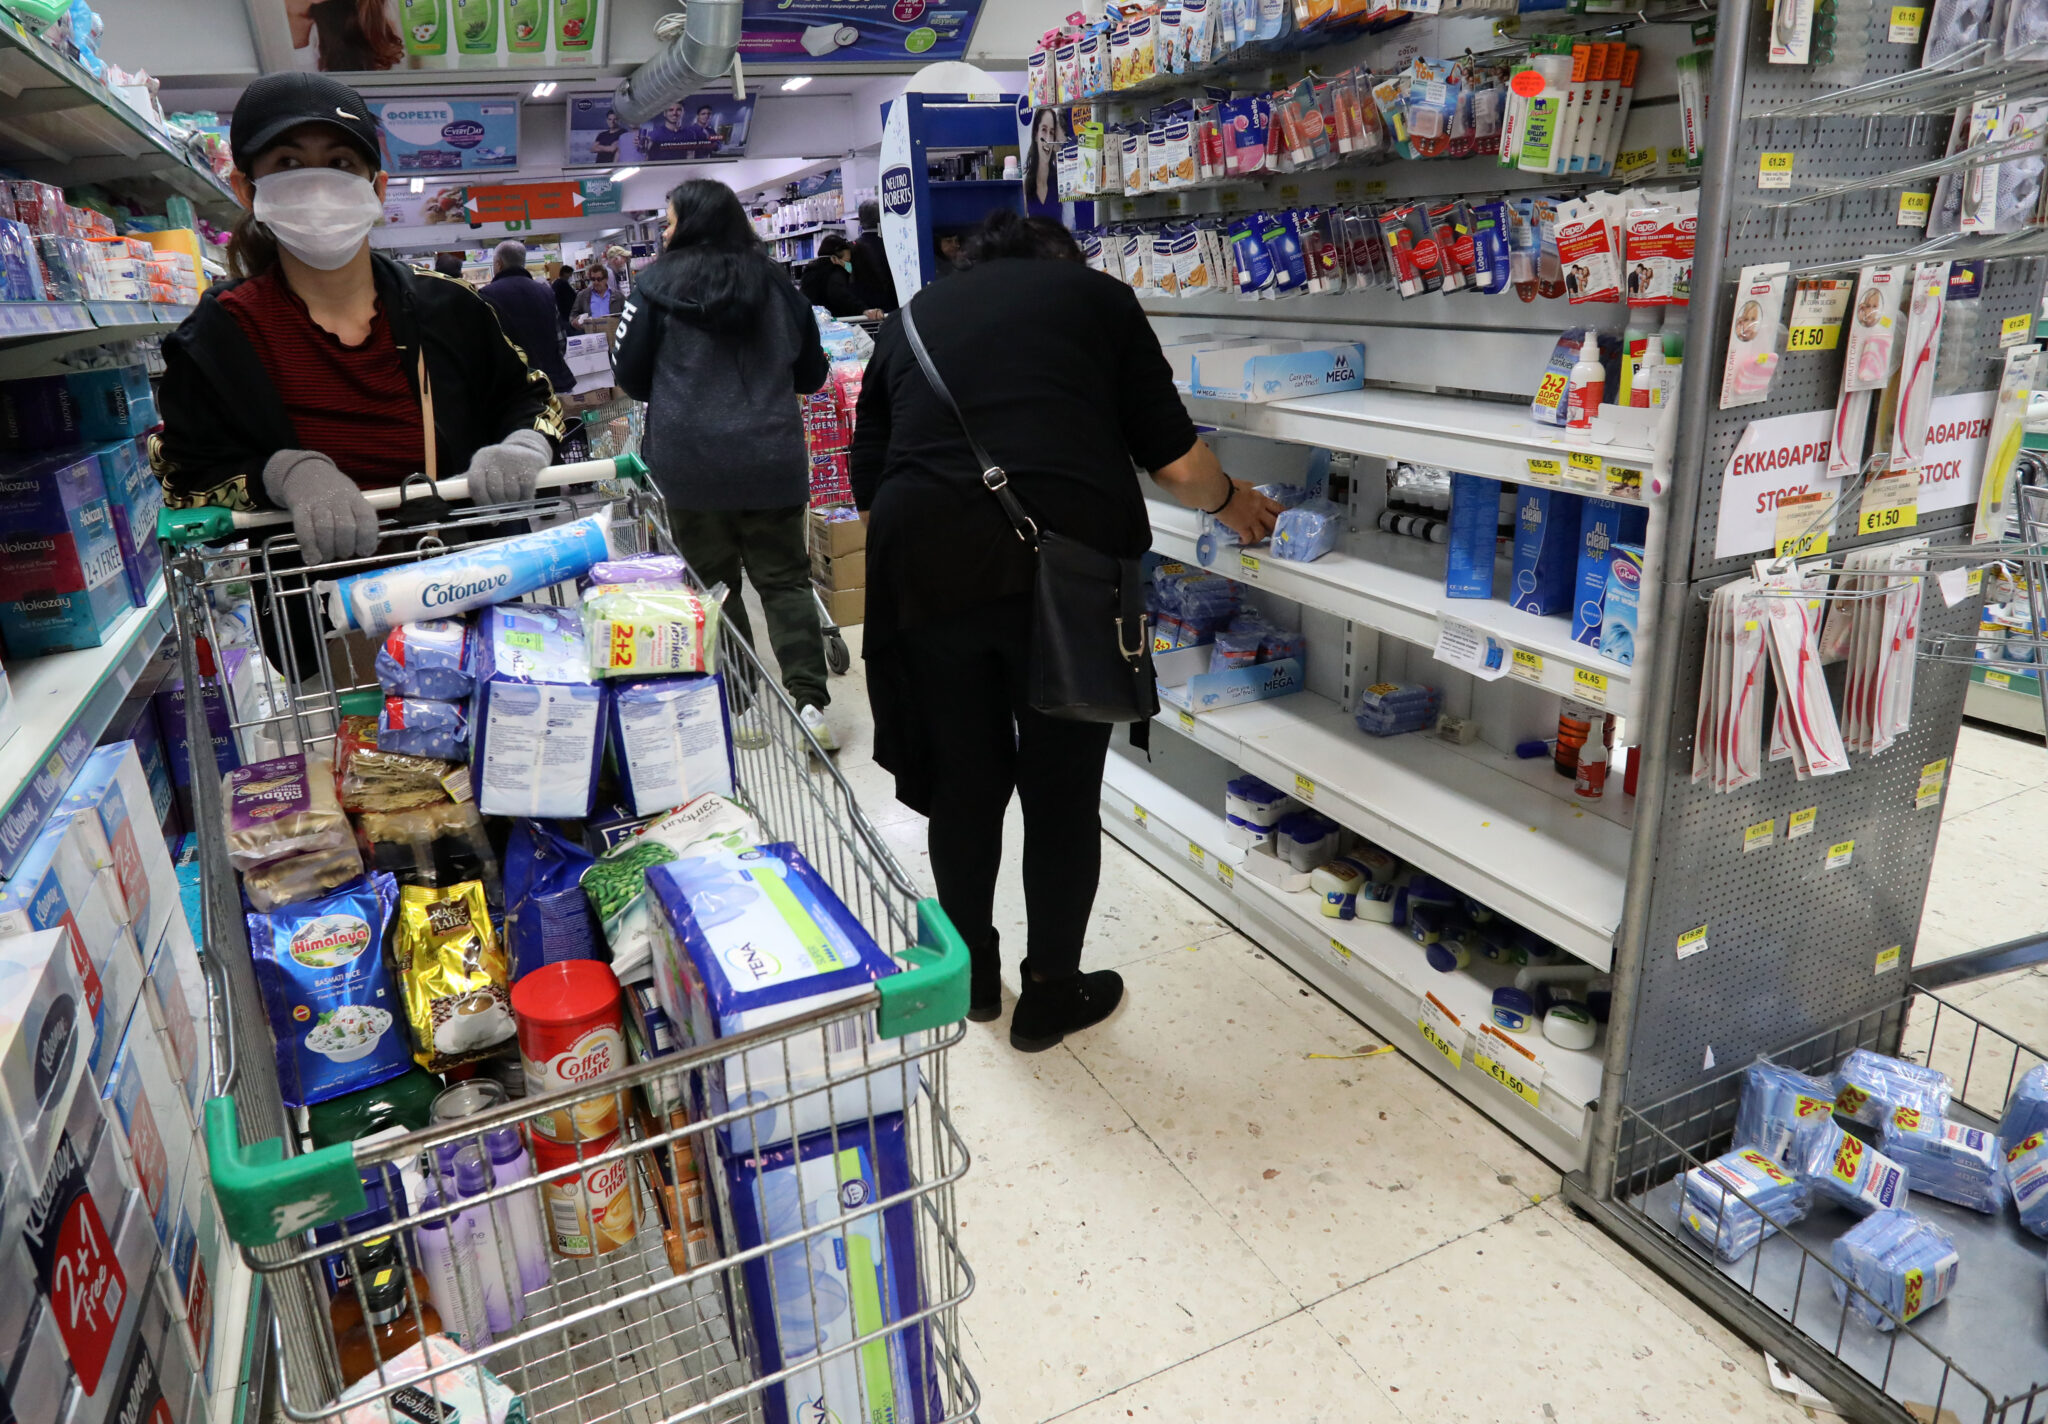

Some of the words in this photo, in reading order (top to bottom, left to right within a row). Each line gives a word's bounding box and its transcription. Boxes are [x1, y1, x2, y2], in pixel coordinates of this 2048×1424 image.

[1899, 12, 1916, 22] €1.15
[387, 110, 447, 120] ΦΟΡΕΣΤΕ
[1503, 135, 1512, 158] After
[1688, 130, 1697, 154] After
[1768, 157, 1787, 168] €1.25
[885, 173, 907, 190] NEUTRO
[884, 187, 912, 207] ROBERTS
[1908, 197, 1924, 206] €1.00
[1476, 240, 1485, 271] Labello
[1792, 328, 1824, 346] €1.50
[1551, 356, 1574, 369] hankies
[1289, 373, 1301, 382] Care
[1302, 374, 1313, 383] you
[1326, 369, 1356, 383] MEGA
[1541, 374, 1566, 393] 2+2
[113, 382, 128, 425] Alokozay
[1538, 390, 1560, 400] ΔΩΡΟ
[1925, 417, 1992, 446] ΑΘΑΡΙΣΗ
[1572, 454, 1594, 465] €1.95
[0, 477, 40, 492] kozay
[1529, 496, 1540, 508] ALL
[1588, 497, 1616, 509] AVIZOR
[80, 505, 104, 526] Alokozay
[1522, 507, 1542, 524] clean
[1867, 510, 1900, 529] €1.50
[1594, 522, 1607, 536] ALL
[1586, 534, 1610, 551] clean
[85, 557, 103, 585] 2+1
[101, 545, 122, 570] FREE
[1586, 548, 1604, 563] Soft
[422, 573, 507, 608] Cotoneve
[12, 596, 72, 613] Alokozay
[616, 625, 634, 666] 2+2
[1264, 677, 1294, 691] MEGA
[1578, 671, 1600, 685] €4.45
[36, 886, 61, 923] Kleenex
[293, 928, 368, 954] Himalaya
[740, 941, 768, 981] TENA
[314, 973, 344, 988] BASMATI
[345, 968, 361, 982] RICE
[40, 1016, 68, 1075] Kleenex
[1423, 1026, 1449, 1055] €1.50
[556, 1046, 609, 1080] Coffee
[574, 1057, 610, 1083] mate
[1491, 1064, 1523, 1094] €1.50
[1896, 1106, 1920, 1128] 2+2
[1745, 1153, 1784, 1181] 2+2
[1838, 1136, 1863, 1178] 2+2
[587, 1159, 626, 1194] Coffe
[604, 1172, 627, 1198] mat
[1881, 1171, 1898, 1203] SEPTONA
[23, 1139, 75, 1248] Kleenex
[1904, 1274, 1923, 1315] 2+2
[813, 1395, 827, 1424] NA
